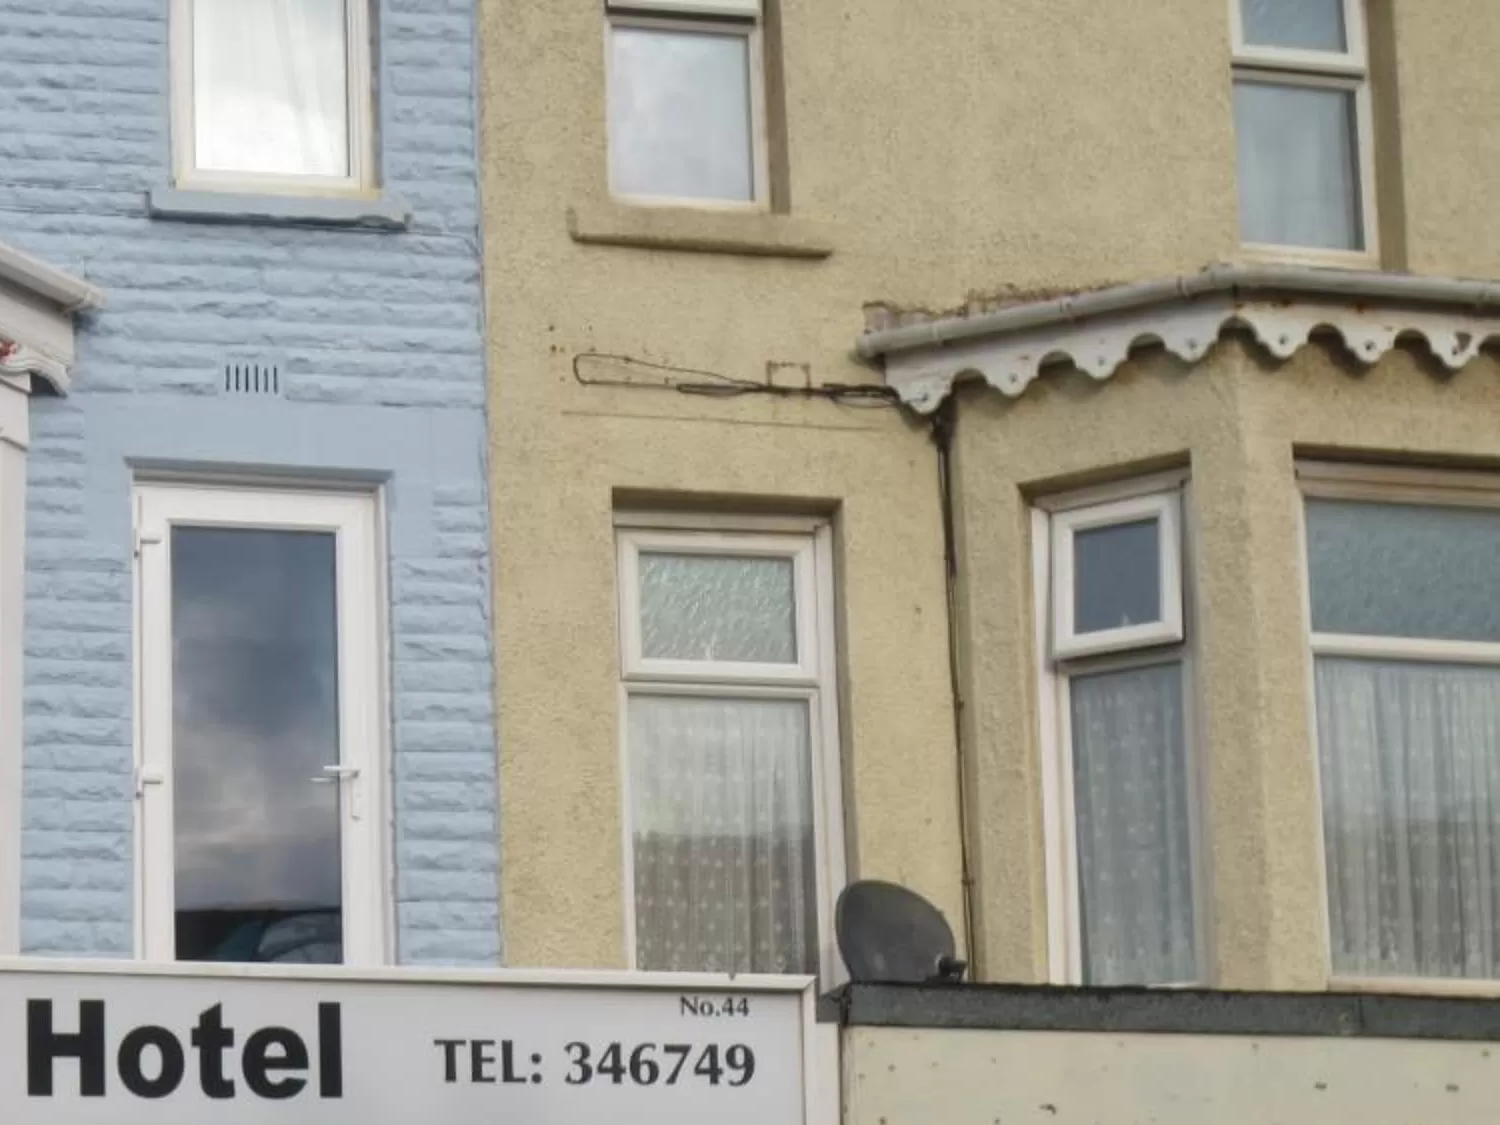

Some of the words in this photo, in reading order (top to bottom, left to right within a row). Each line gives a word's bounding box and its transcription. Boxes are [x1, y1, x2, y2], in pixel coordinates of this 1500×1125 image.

[680, 996, 750, 1017] No.44
[28, 999, 343, 1100] Hotel
[434, 1039, 542, 1084] TEL:
[564, 1041, 755, 1087] 346749
